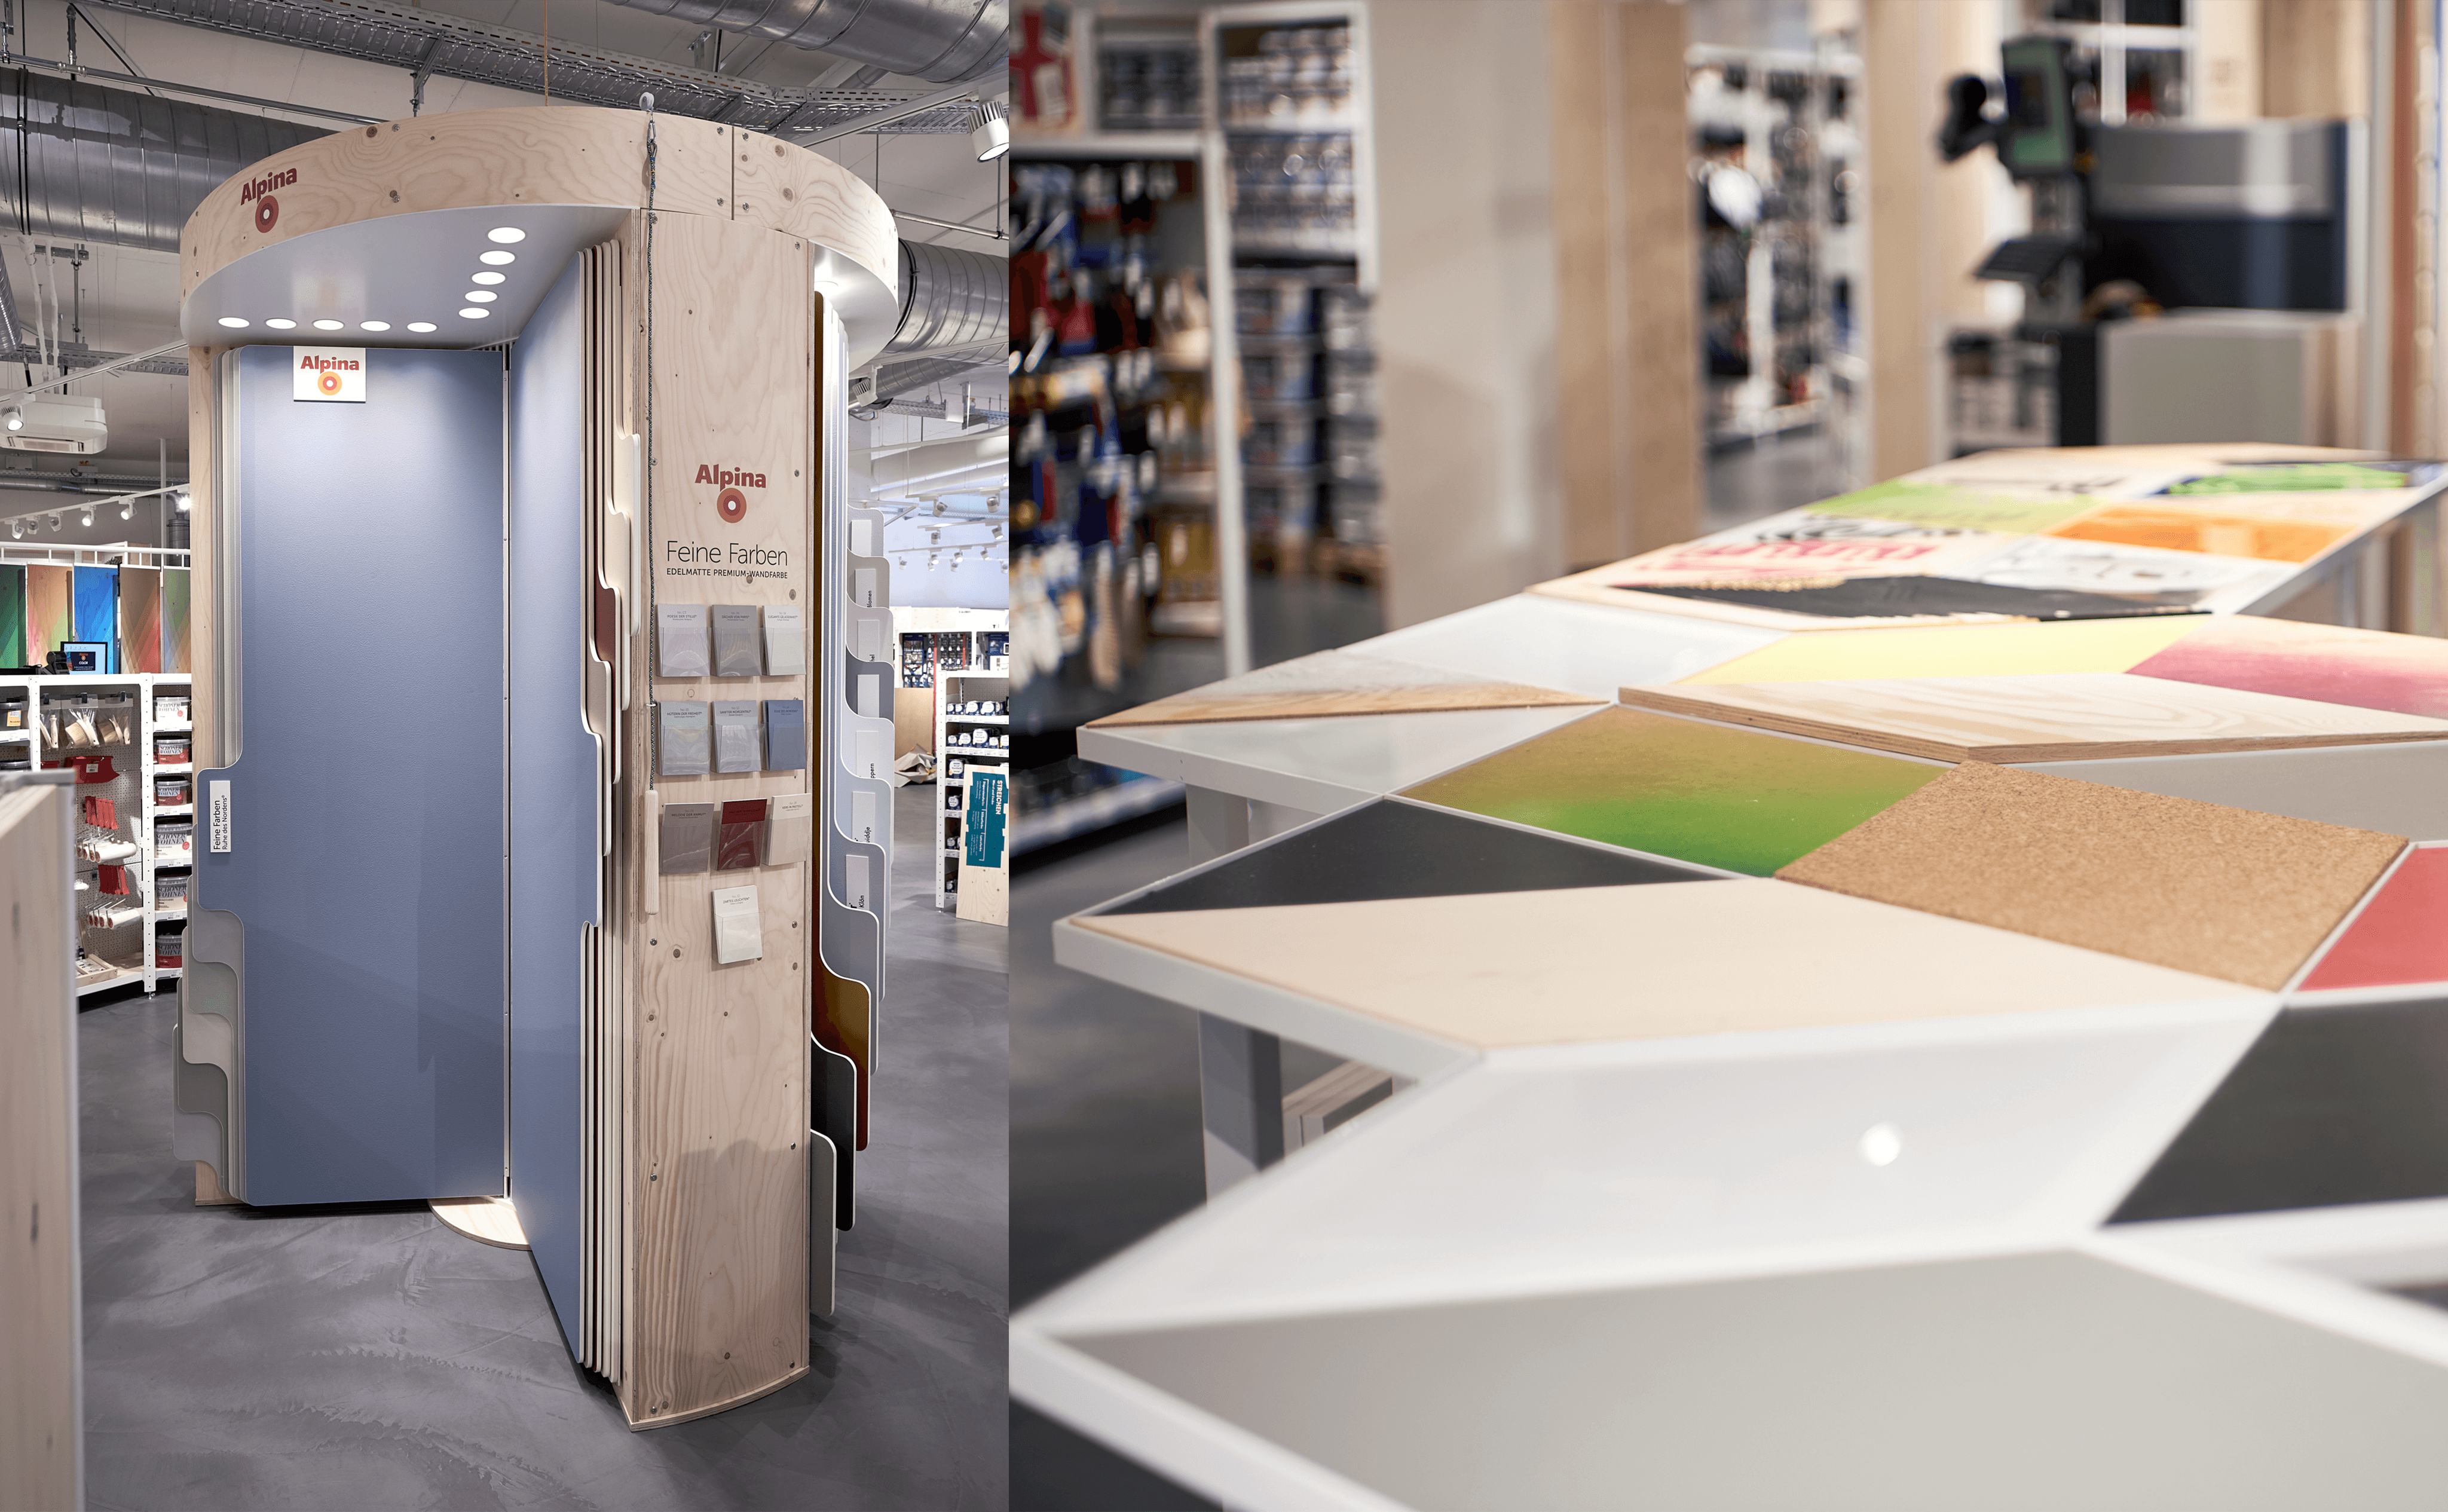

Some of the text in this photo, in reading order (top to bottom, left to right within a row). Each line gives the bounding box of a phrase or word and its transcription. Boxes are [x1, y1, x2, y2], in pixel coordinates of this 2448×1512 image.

[240, 168, 298, 206] Alpina
[300, 355, 360, 374] Alpina
[694, 464, 767, 492] Alpina
[667, 540, 788, 566] Feine Farben
[666, 567, 788, 579] EDELMATTE PREMIUM-WANDFARBE
